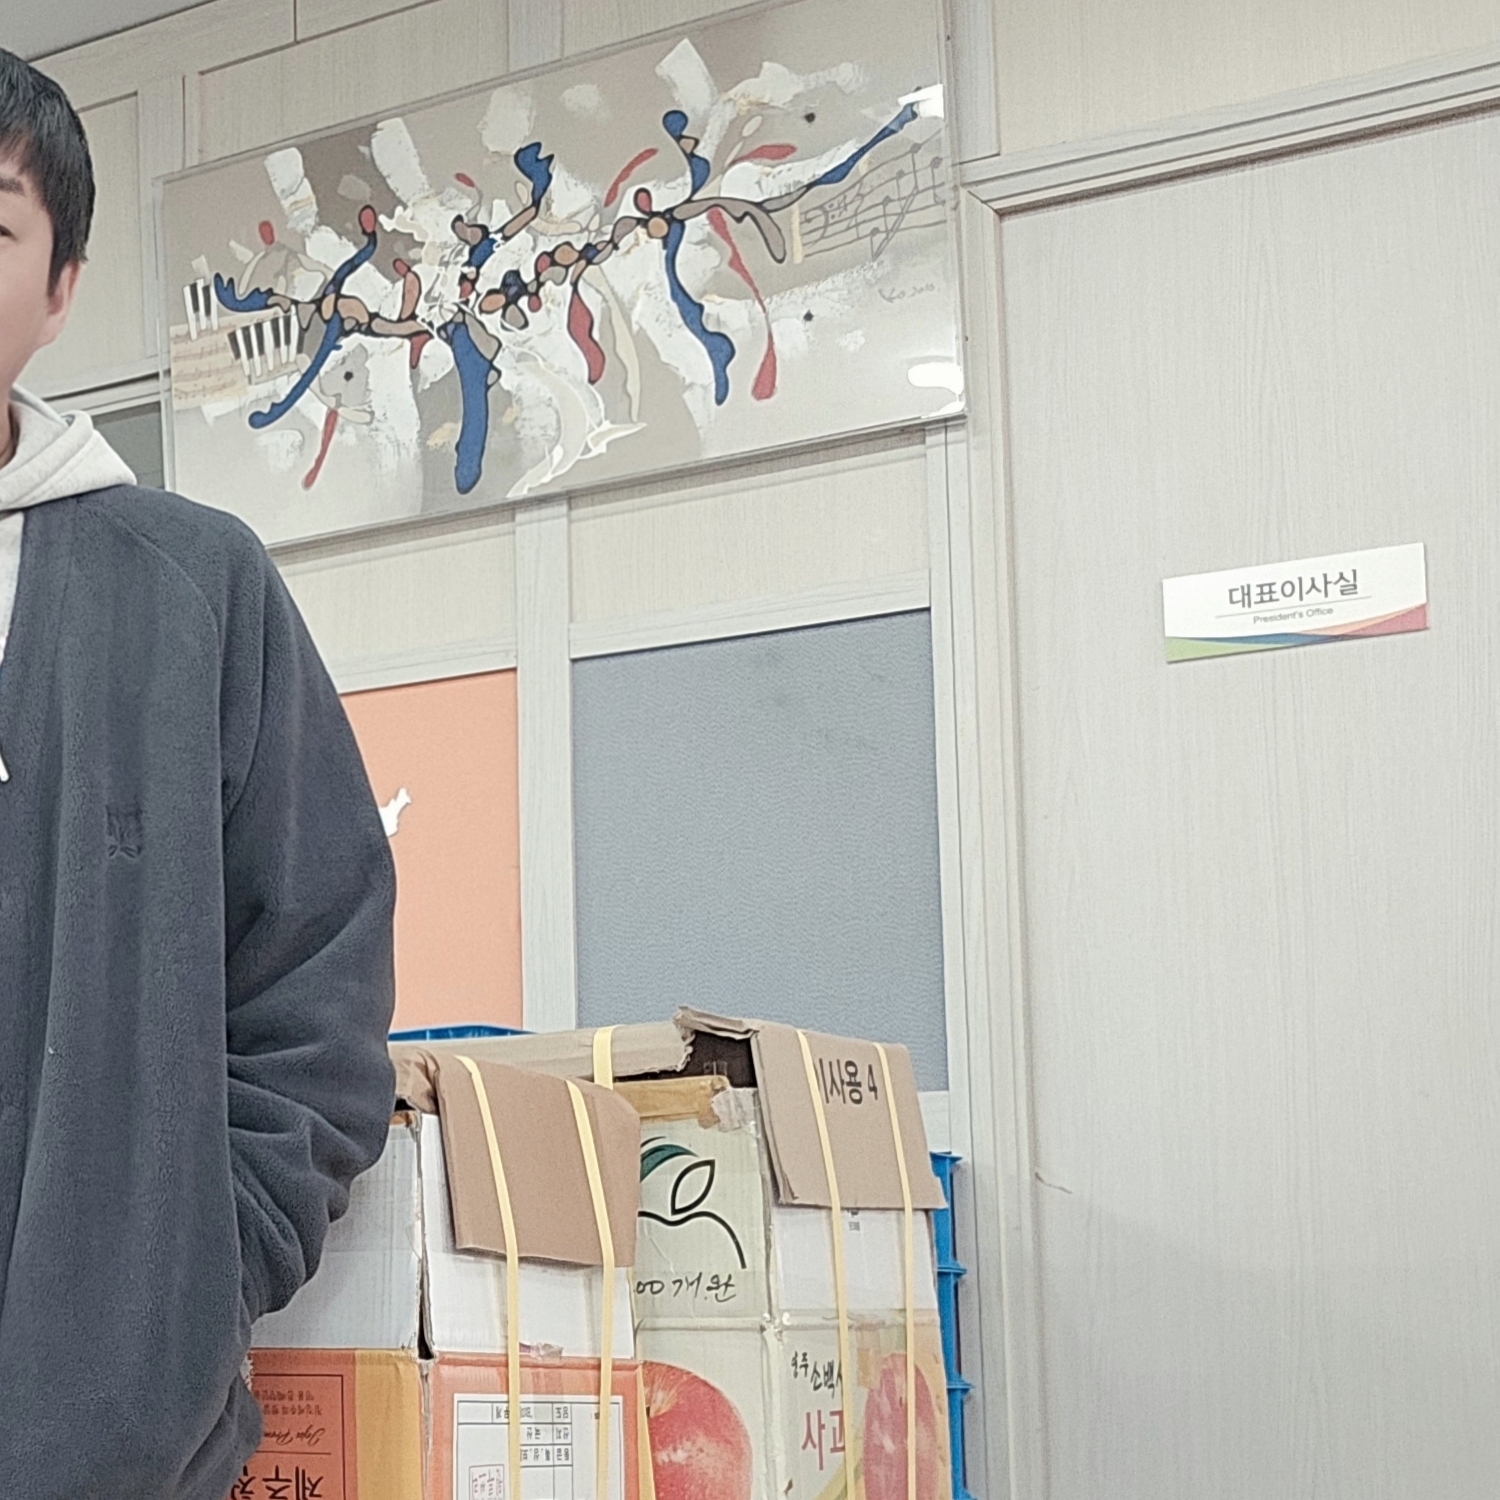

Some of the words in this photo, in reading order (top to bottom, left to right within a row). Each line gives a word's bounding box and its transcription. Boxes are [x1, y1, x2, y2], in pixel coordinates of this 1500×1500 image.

[1228, 569, 1359, 609] 대표이사실
[1253, 610, 1304, 625] President's
[1305, 607, 1334, 618] Office
[867, 1064, 878, 1101] 4
